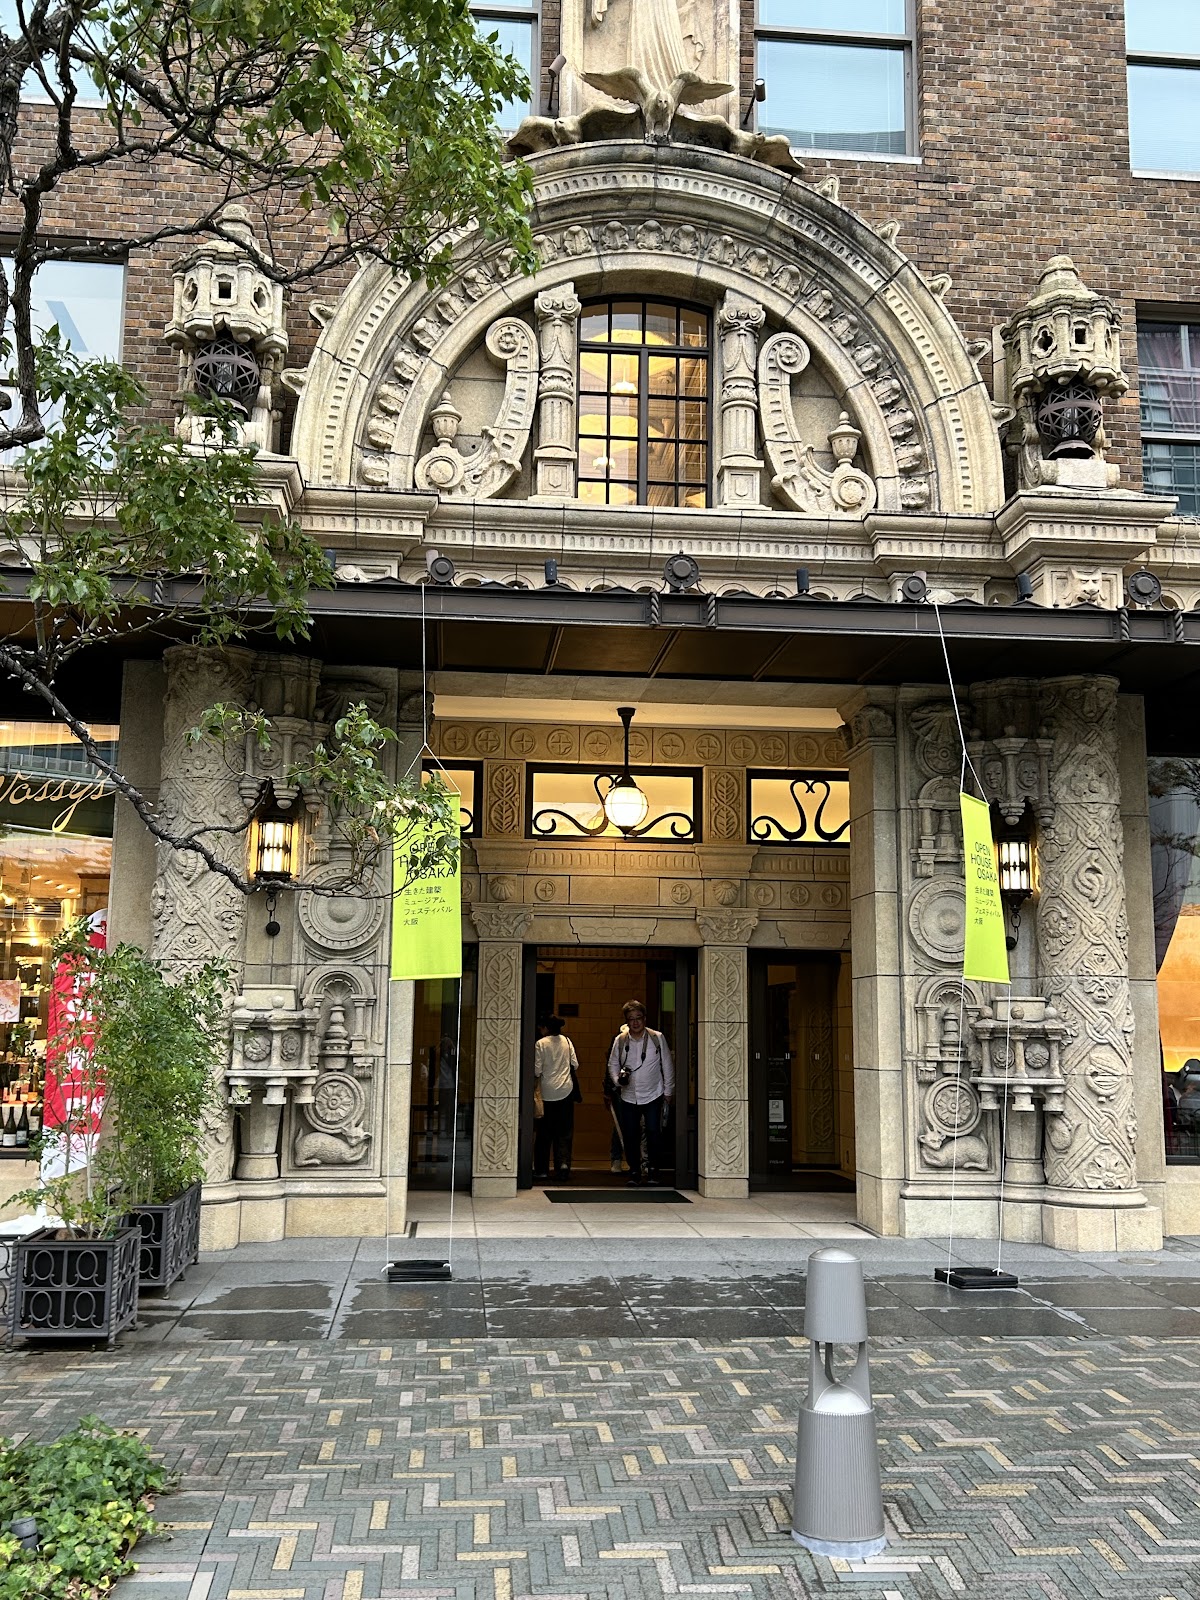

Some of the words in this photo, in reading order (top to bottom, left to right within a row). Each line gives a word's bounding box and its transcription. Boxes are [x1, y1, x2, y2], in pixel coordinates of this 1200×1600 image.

[975, 841, 991, 856] OPEN
[970, 853, 993, 870] HOUSE
[976, 867, 998, 883] OSAKA
[403, 886, 442, 896] 生きた建築
[404, 897, 446, 906] ミュージアム
[403, 906, 453, 916] フェスティバル
[403, 917, 419, 926] 大阪
[0, 1007, 15, 1020] イン
